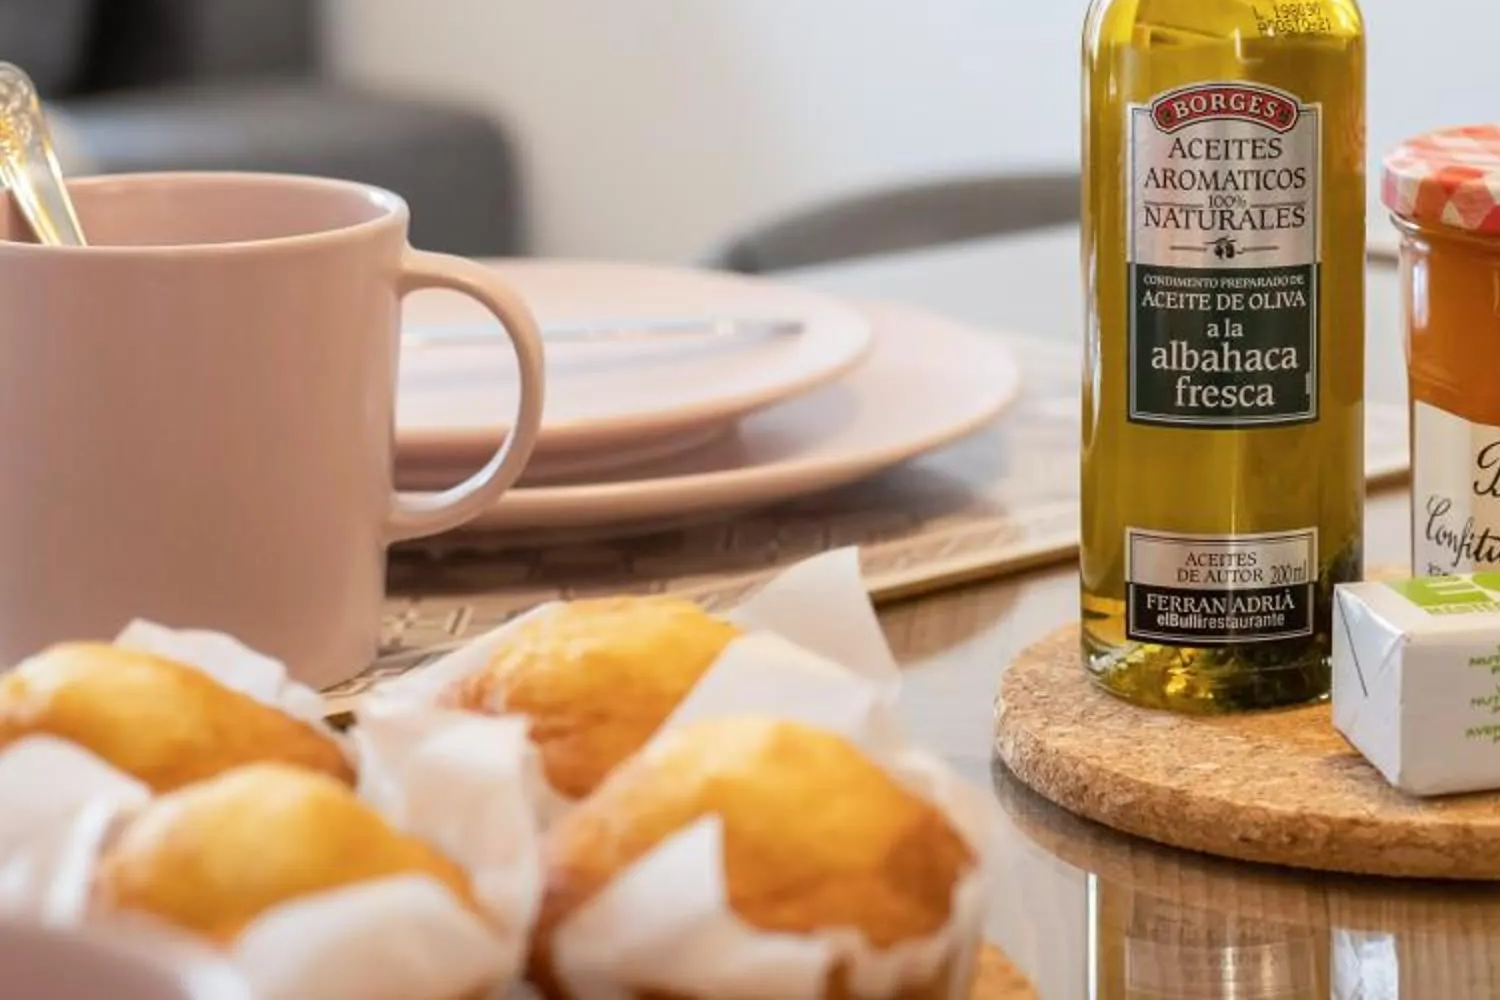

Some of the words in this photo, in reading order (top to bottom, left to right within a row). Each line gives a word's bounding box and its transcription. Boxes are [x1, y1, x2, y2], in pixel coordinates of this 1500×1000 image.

[1173, 94, 1277, 119] BORGES
[1168, 137, 1283, 161] ACEITES
[1144, 167, 1307, 191] AROMATICOS
[1208, 195, 1247, 209] 100%
[1143, 205, 1306, 230] NATURALES
[1143, 274, 1218, 288] CONDIMENTO
[1220, 276, 1289, 288] PREPARADO
[1289, 275, 1304, 285] DE
[1141, 290, 1212, 310] ACEITE
[1216, 293, 1245, 310] DE
[1248, 290, 1306, 310] OLIVA
[1207, 322, 1219, 337] a
[1224, 317, 1244, 337] la
[1151, 340, 1299, 373] albahaca
[1175, 376, 1275, 408] fresca
[1185, 551, 1257, 567] ACEITES
[1176, 569, 1203, 583] DE
[1203, 568, 1264, 584] AUTOR
[1146, 593, 1229, 614] FERRAN
